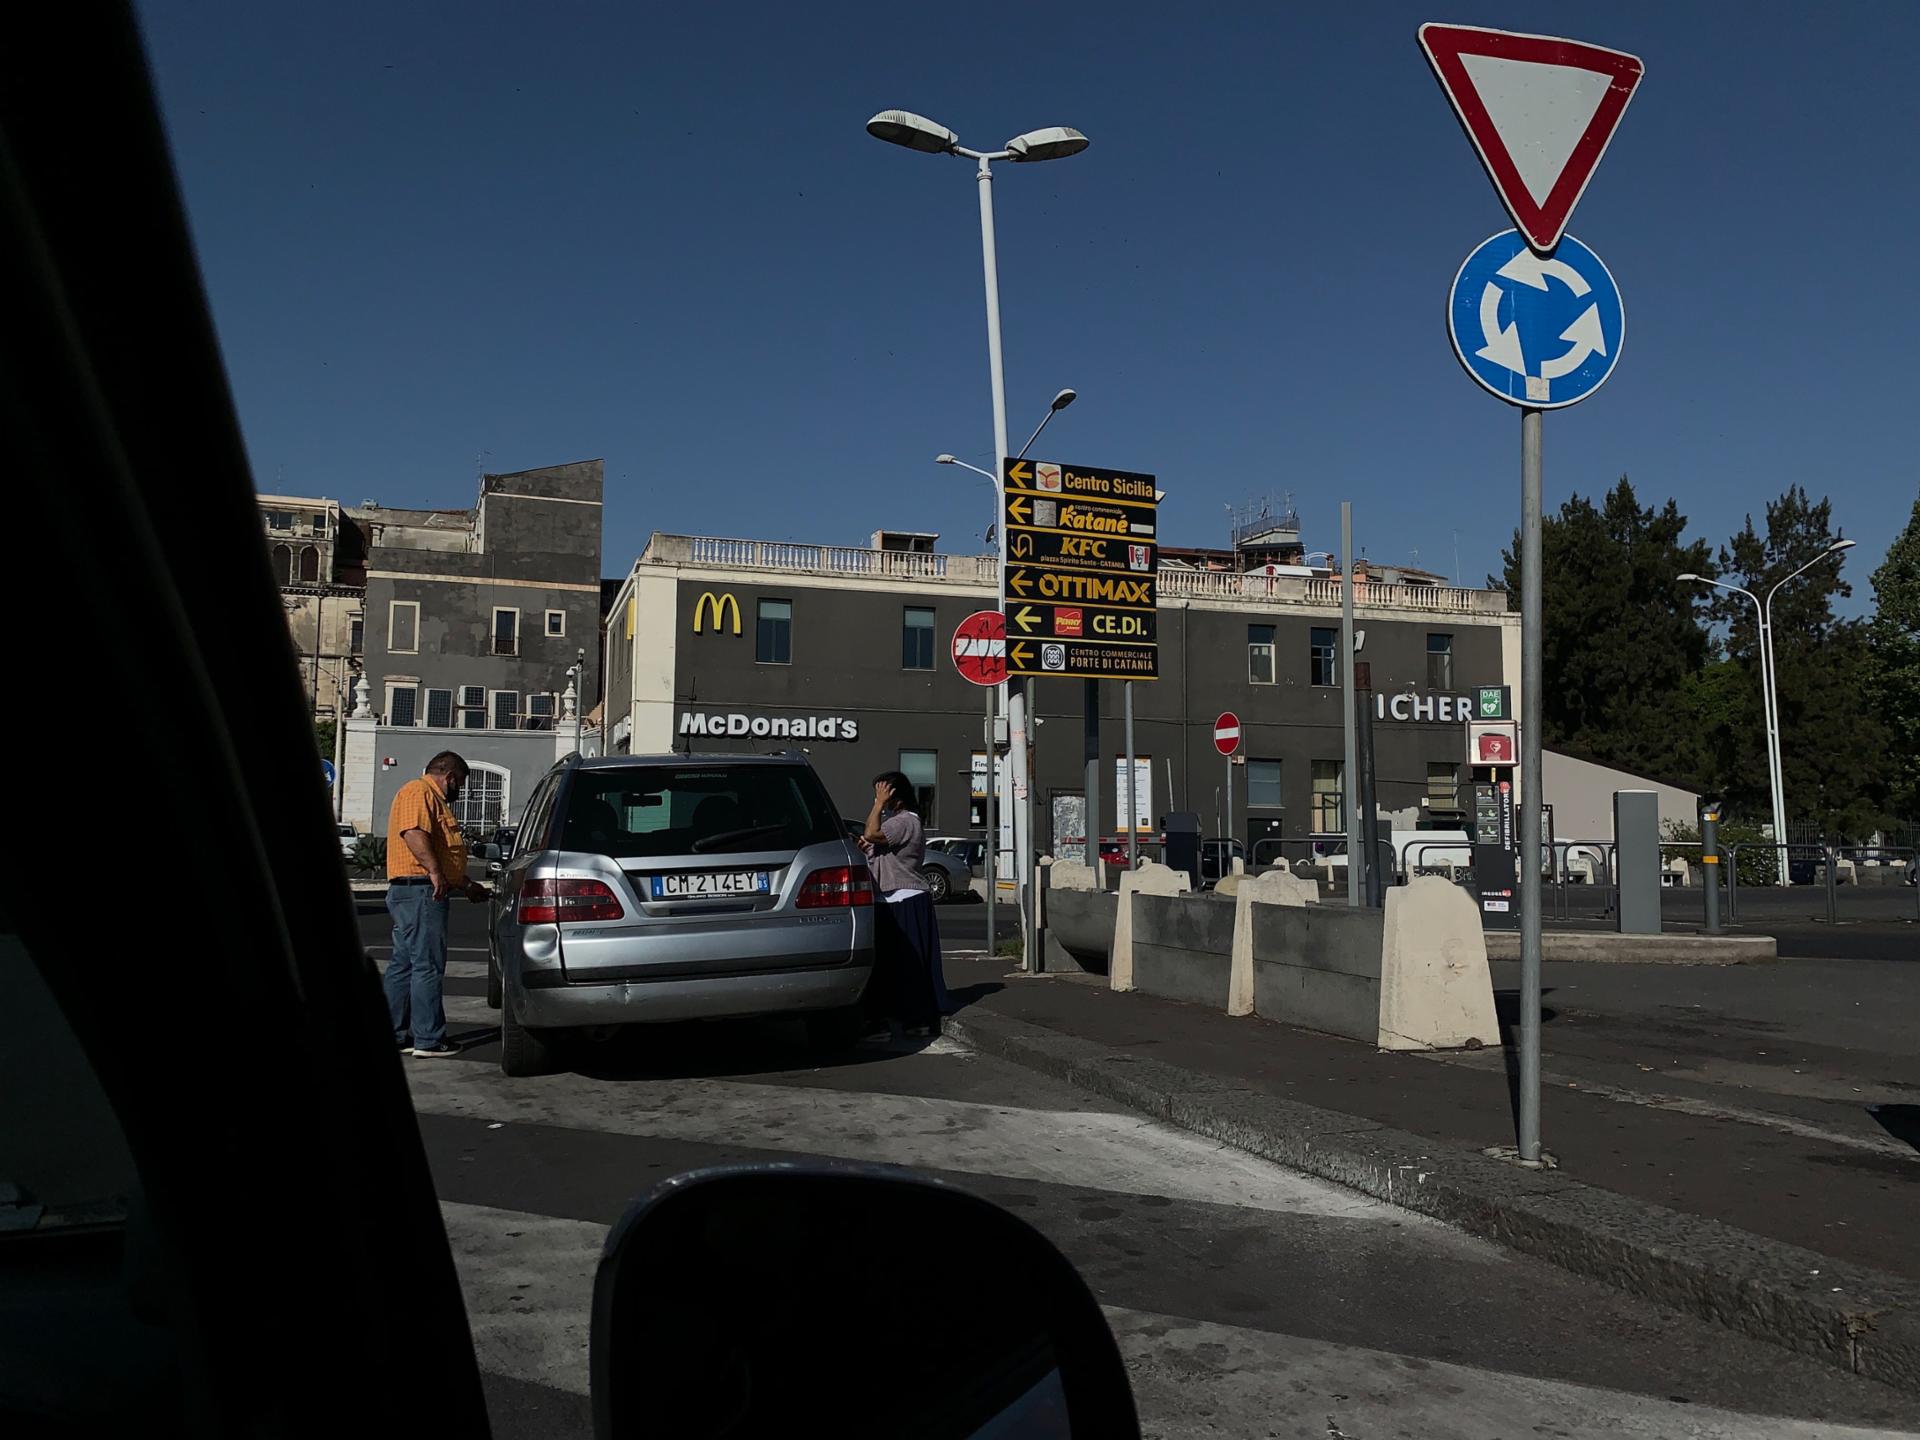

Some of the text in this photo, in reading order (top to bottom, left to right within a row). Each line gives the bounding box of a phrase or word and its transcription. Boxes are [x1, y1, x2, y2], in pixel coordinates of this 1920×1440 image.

[1065, 472, 1153, 498] Centro Sicilia
[1060, 536, 1108, 559] KFC
[1100, 560, 1125, 569] CATANIA
[1039, 573, 1151, 604] OTTIMAX
[1092, 614, 1147, 636] CE.DI.
[1070, 648, 1152, 660] CENTRO COMMERCIALE
[1070, 657, 1153, 671] PORTE DI CATANIA
[1482, 690, 1500, 698] DAE
[1377, 693, 1473, 721] ICHER
[680, 712, 858, 738] McDonald's
